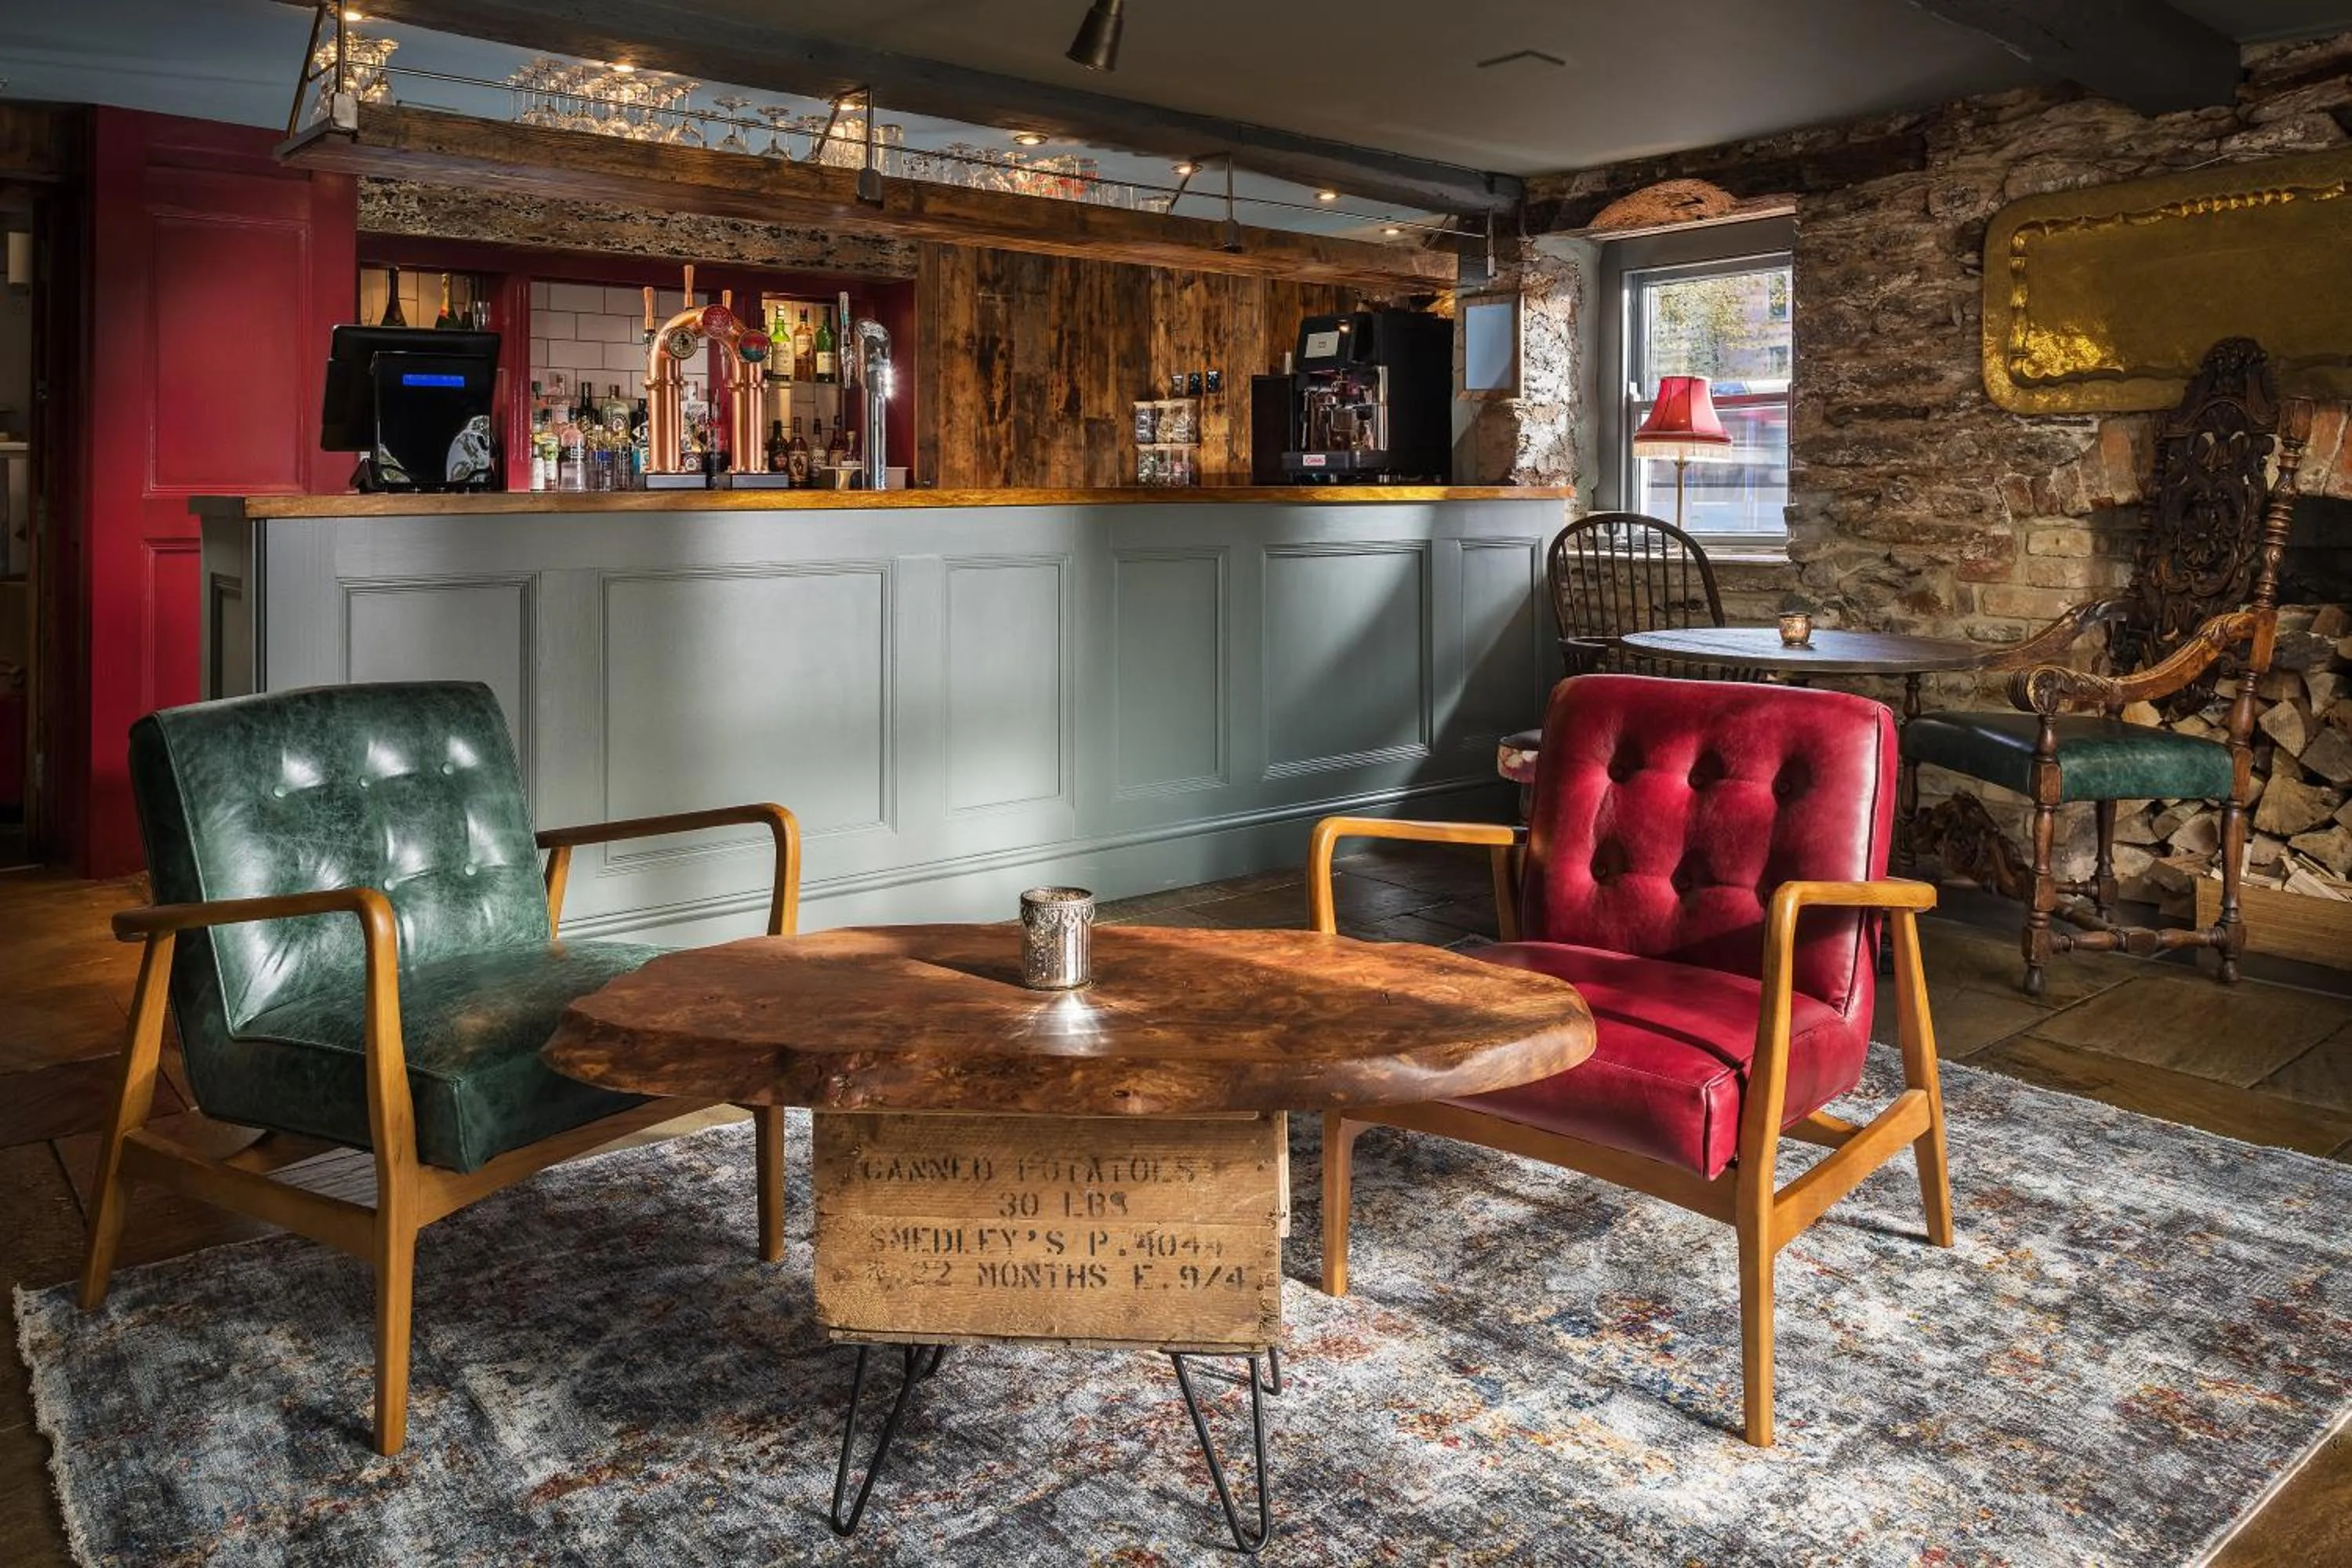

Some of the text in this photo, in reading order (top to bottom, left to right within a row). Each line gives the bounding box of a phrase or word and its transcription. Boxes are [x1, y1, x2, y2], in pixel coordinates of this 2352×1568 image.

[998, 1190, 1128, 1218] 30 LBS
[978, 1260, 1108, 1290] MONTHS
